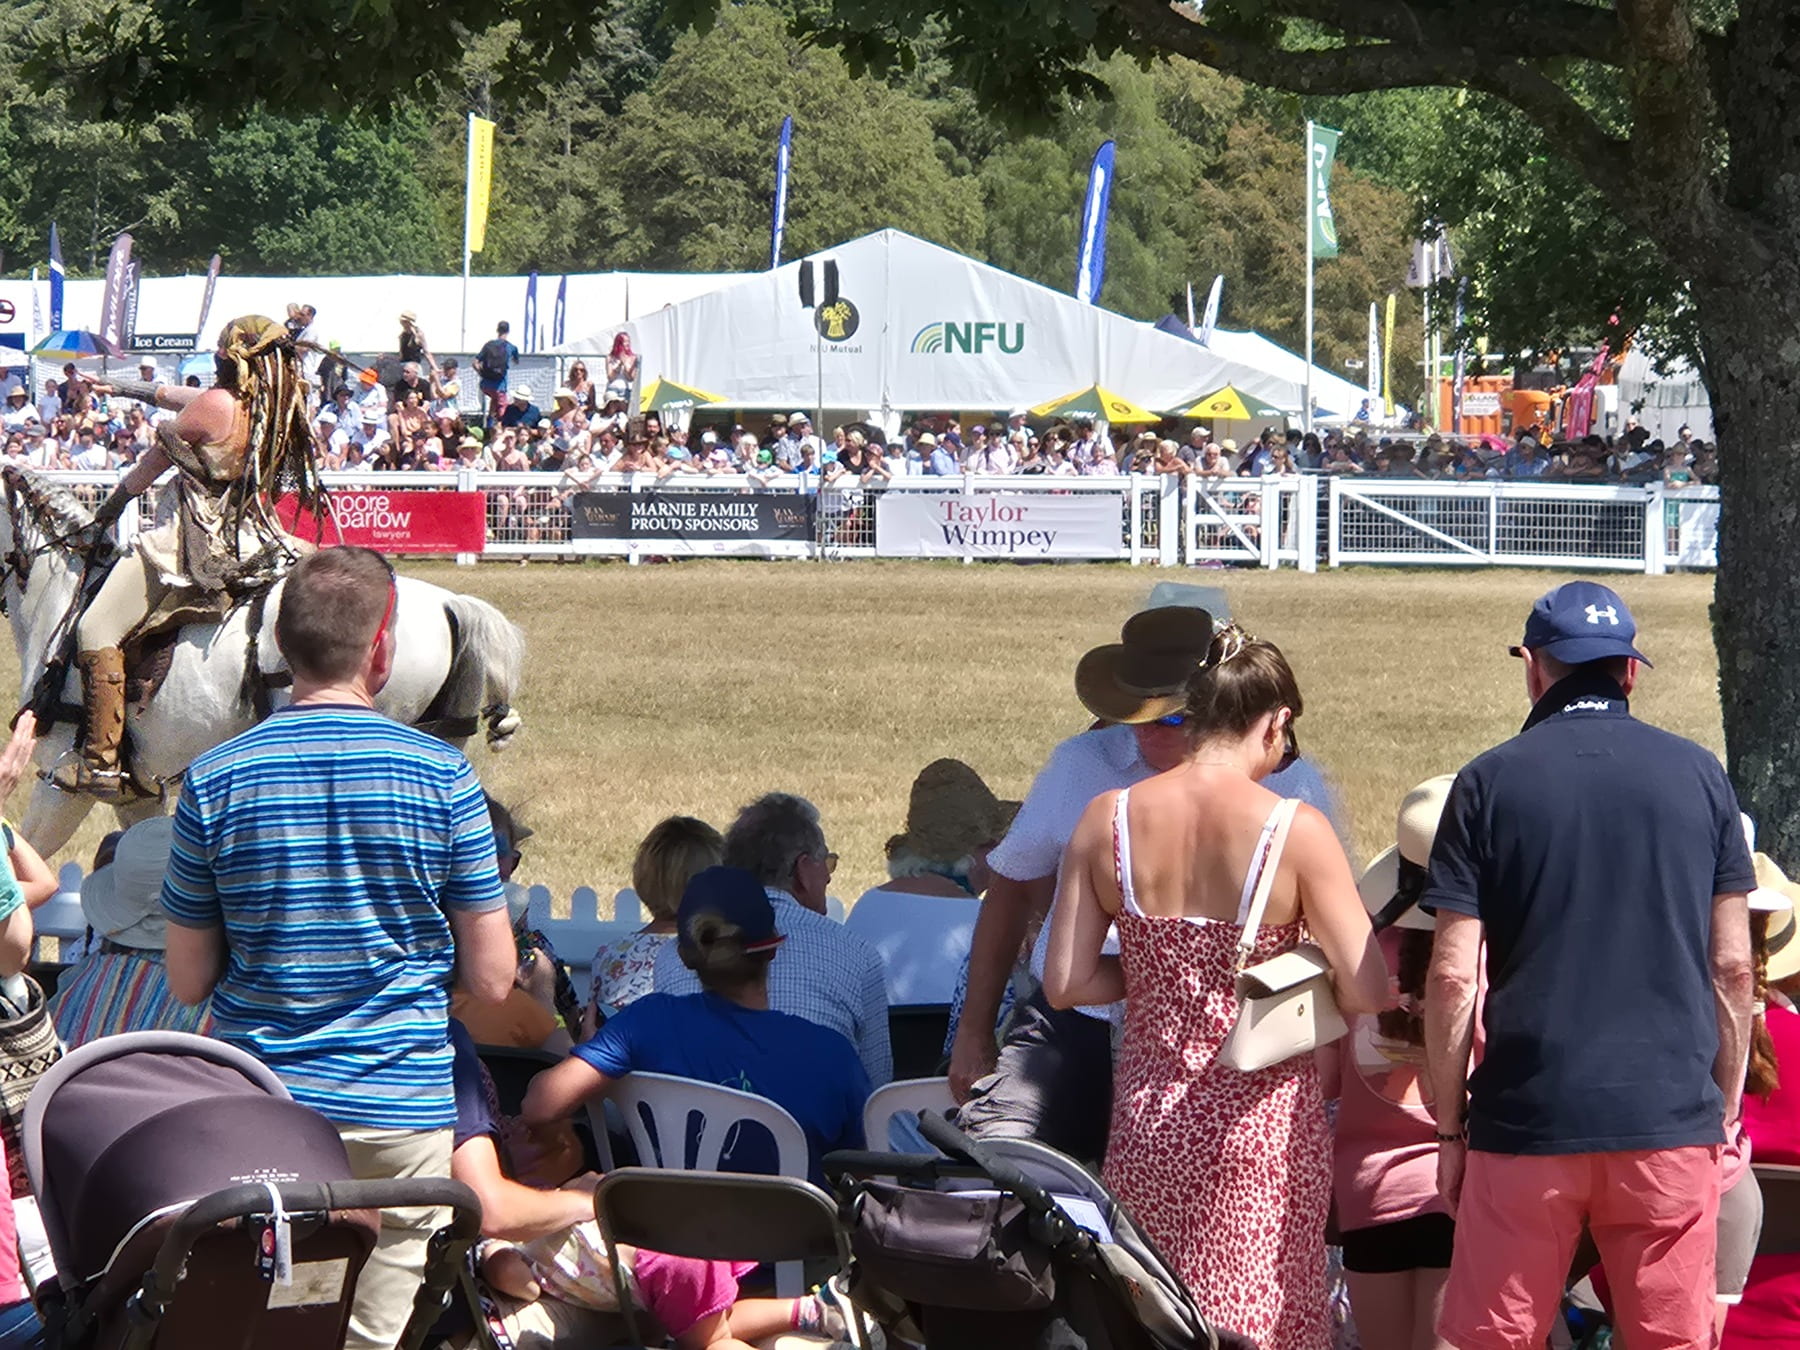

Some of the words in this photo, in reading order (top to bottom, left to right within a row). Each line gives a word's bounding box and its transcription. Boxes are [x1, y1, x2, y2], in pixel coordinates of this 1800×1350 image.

[134, 336, 152, 347] Ice
[155, 336, 193, 347] Cream
[944, 322, 1024, 354] NFU
[810, 344, 828, 353] NU
[830, 344, 863, 353] Mutual
[631, 502, 696, 517] MARNIE
[699, 503, 759, 517] FAMILY
[939, 498, 1029, 528] Taylor
[631, 518, 683, 531] PROUD
[684, 518, 759, 532] SPONSORS
[373, 530, 411, 541] lawyers
[940, 524, 1058, 553] Wimpey
